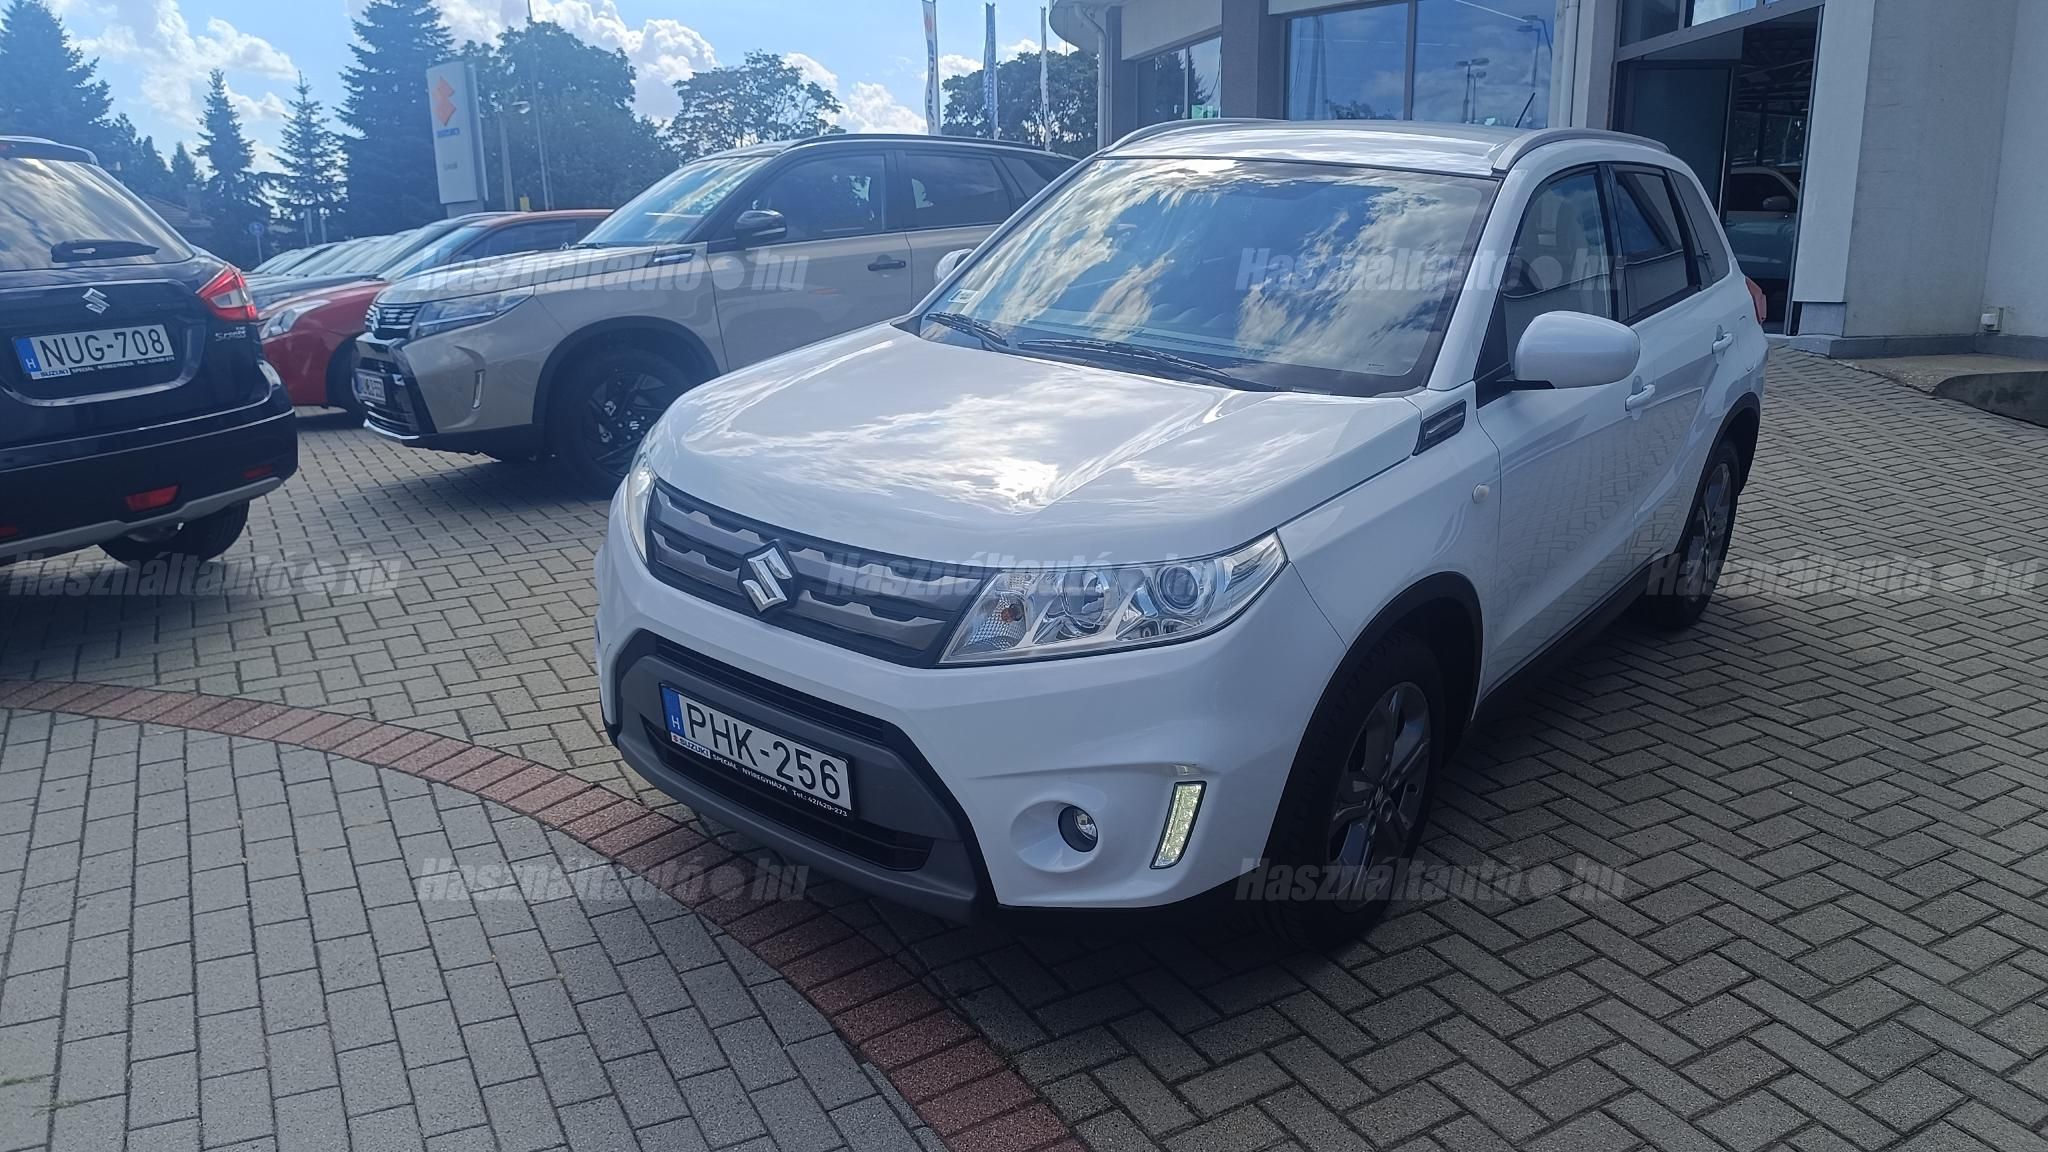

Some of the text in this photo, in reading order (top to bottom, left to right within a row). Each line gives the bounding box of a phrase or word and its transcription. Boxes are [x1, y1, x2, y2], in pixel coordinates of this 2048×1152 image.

[40, 329, 165, 367] NUG-708
[26, 359, 37, 369] H
[671, 715, 681, 730] H
[679, 738, 710, 757] SUZUKI
[686, 703, 840, 800] PHK-256
